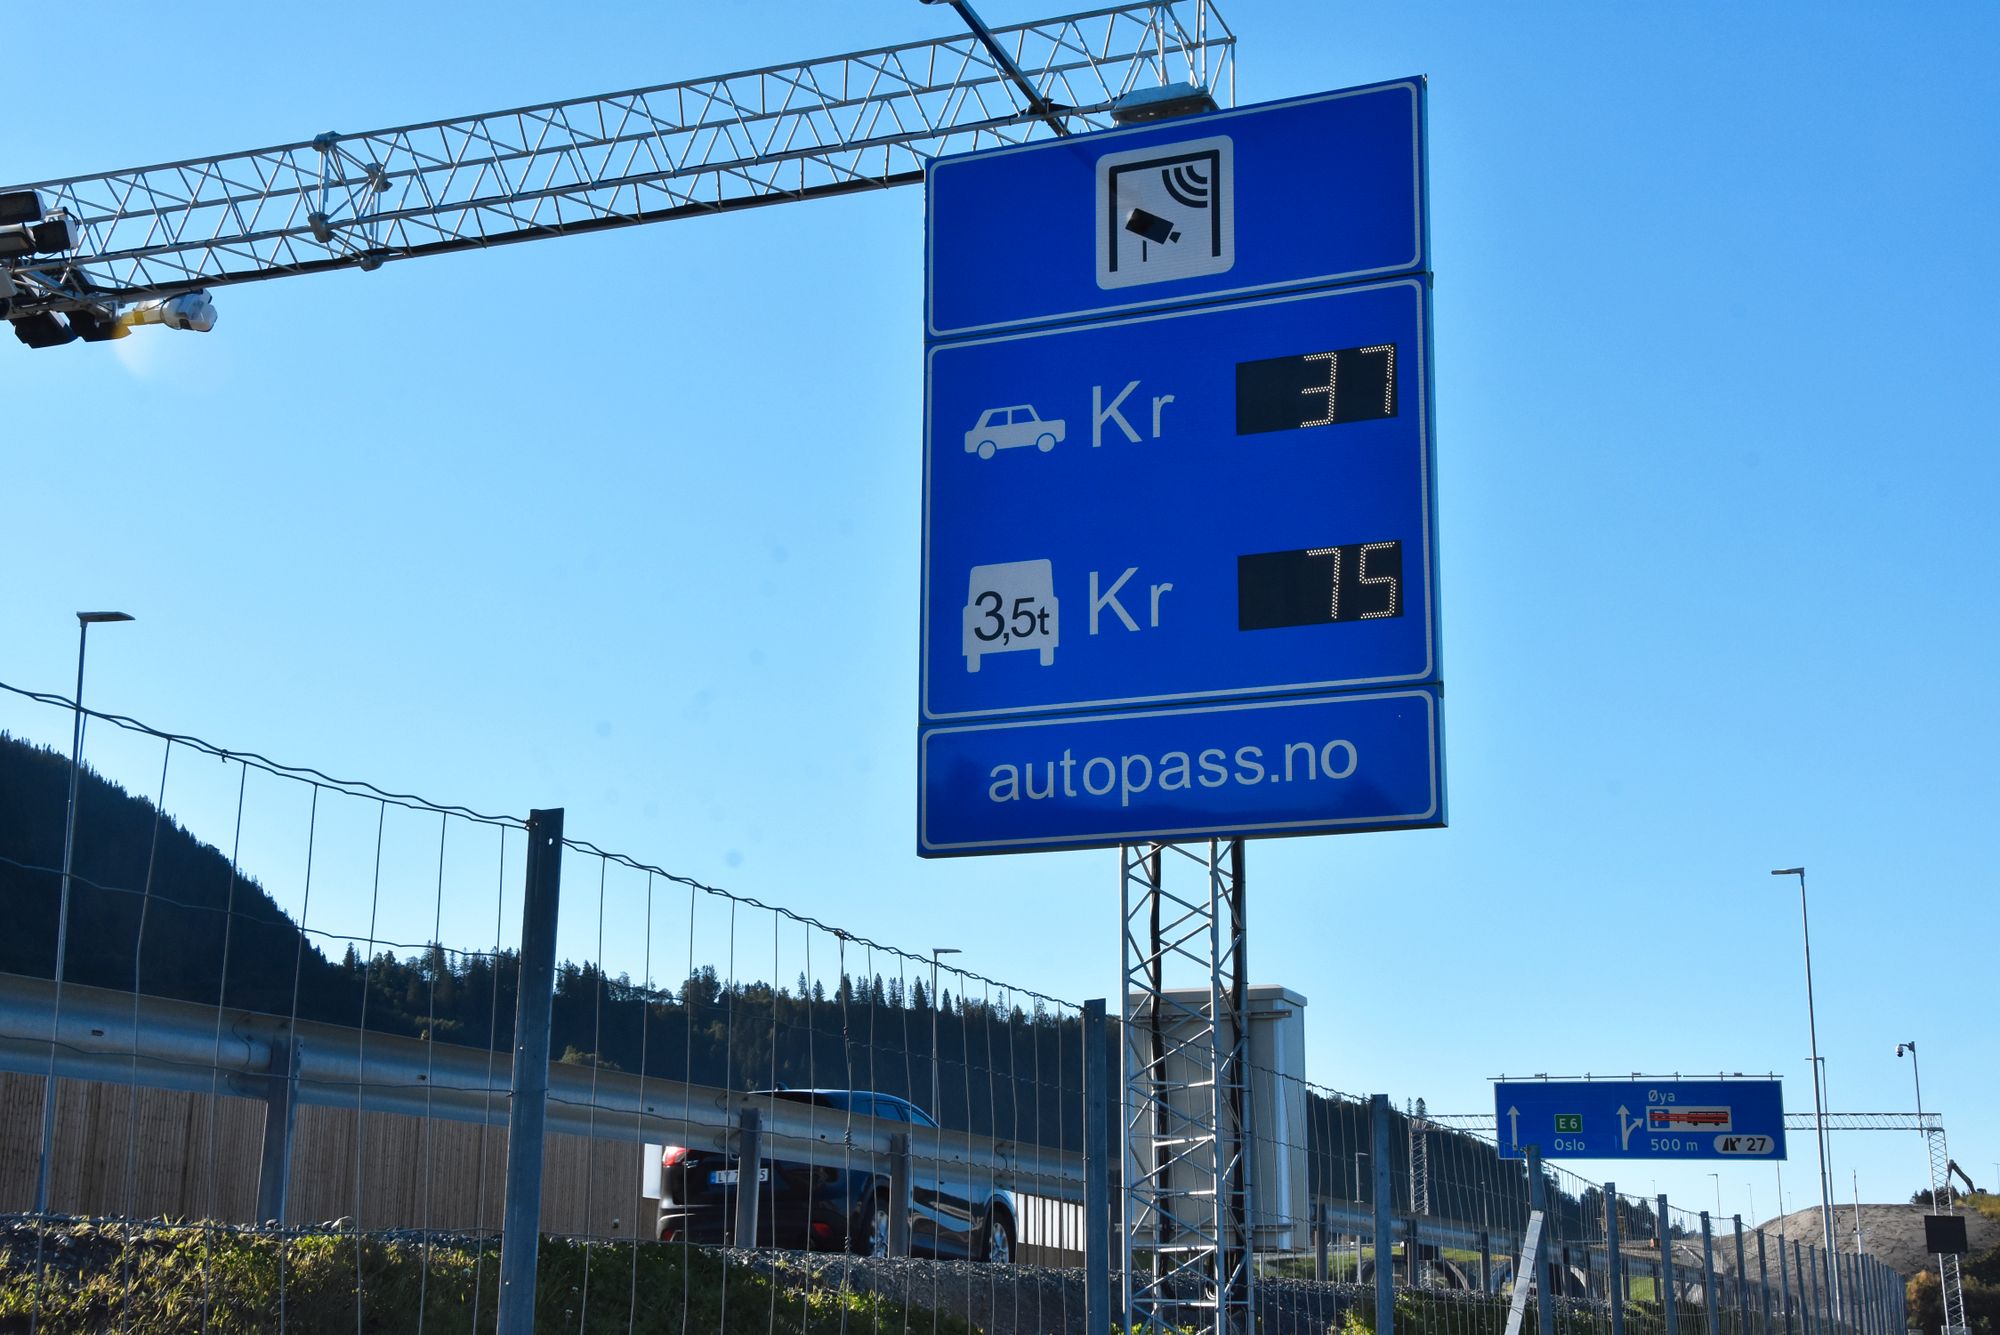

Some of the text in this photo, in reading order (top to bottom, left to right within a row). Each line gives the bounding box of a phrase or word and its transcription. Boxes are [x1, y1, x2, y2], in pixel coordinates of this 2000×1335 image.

[1092, 344, 1395, 447] Kr 37
[1089, 541, 1397, 635] Kr 75
[973, 590, 1051, 647] 3,5t
[988, 738, 1358, 807] autopass.no
[1648, 1089, 1675, 1105] Øya
[1554, 1138, 1585, 1151] Oslo
[1651, 1138, 1698, 1151] 500 m
[1746, 1137, 1767, 1152] 27
